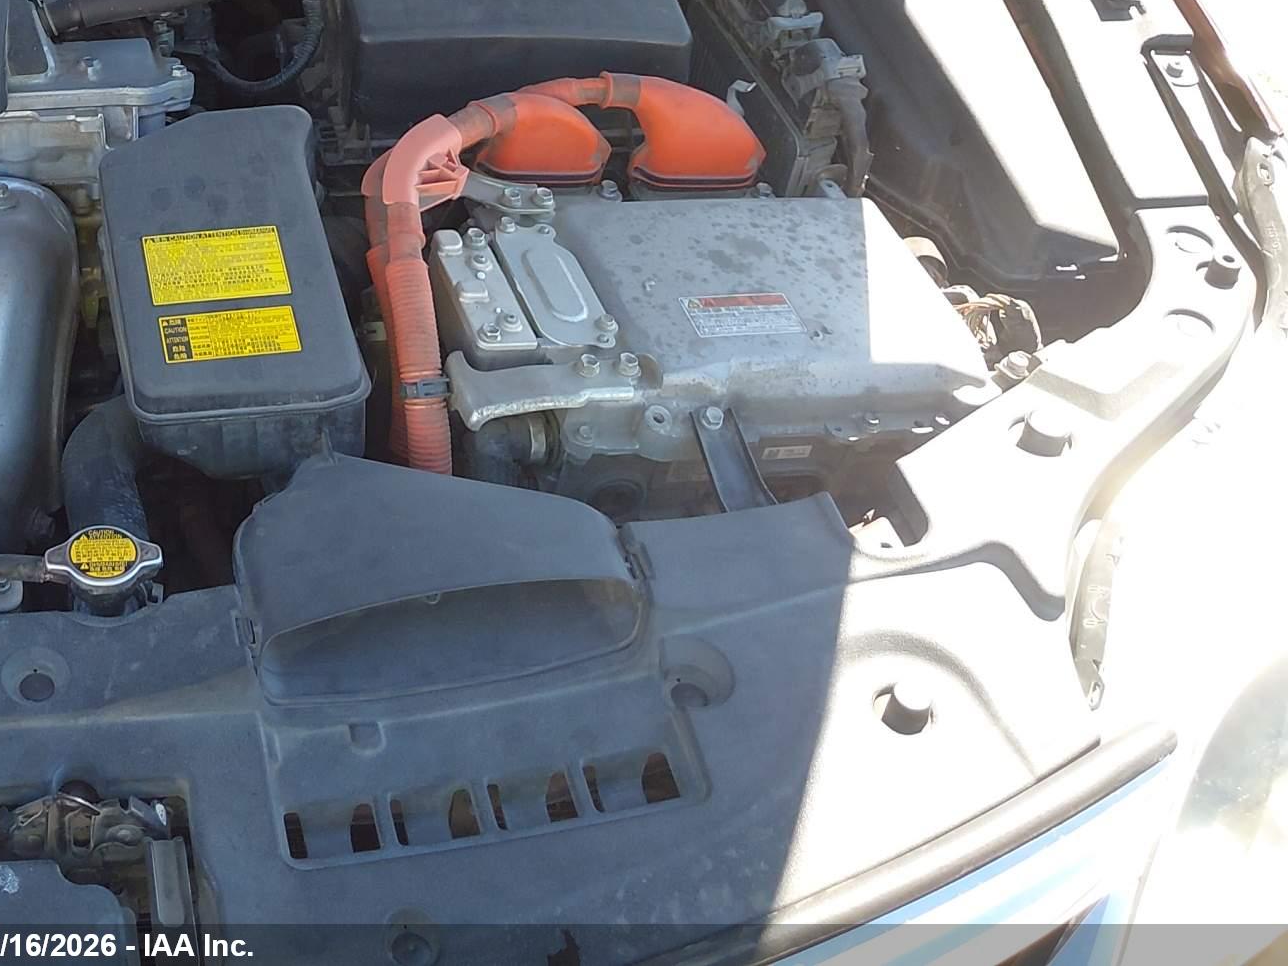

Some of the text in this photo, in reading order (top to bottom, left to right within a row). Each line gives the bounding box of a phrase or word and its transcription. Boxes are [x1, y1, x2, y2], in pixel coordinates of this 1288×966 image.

[168, 233, 200, 242] CAUTION
[201, 229, 239, 239] ATTENTION
[164, 326, 187, 334] CAUTION
[166, 336, 189, 344] ATTENTION
